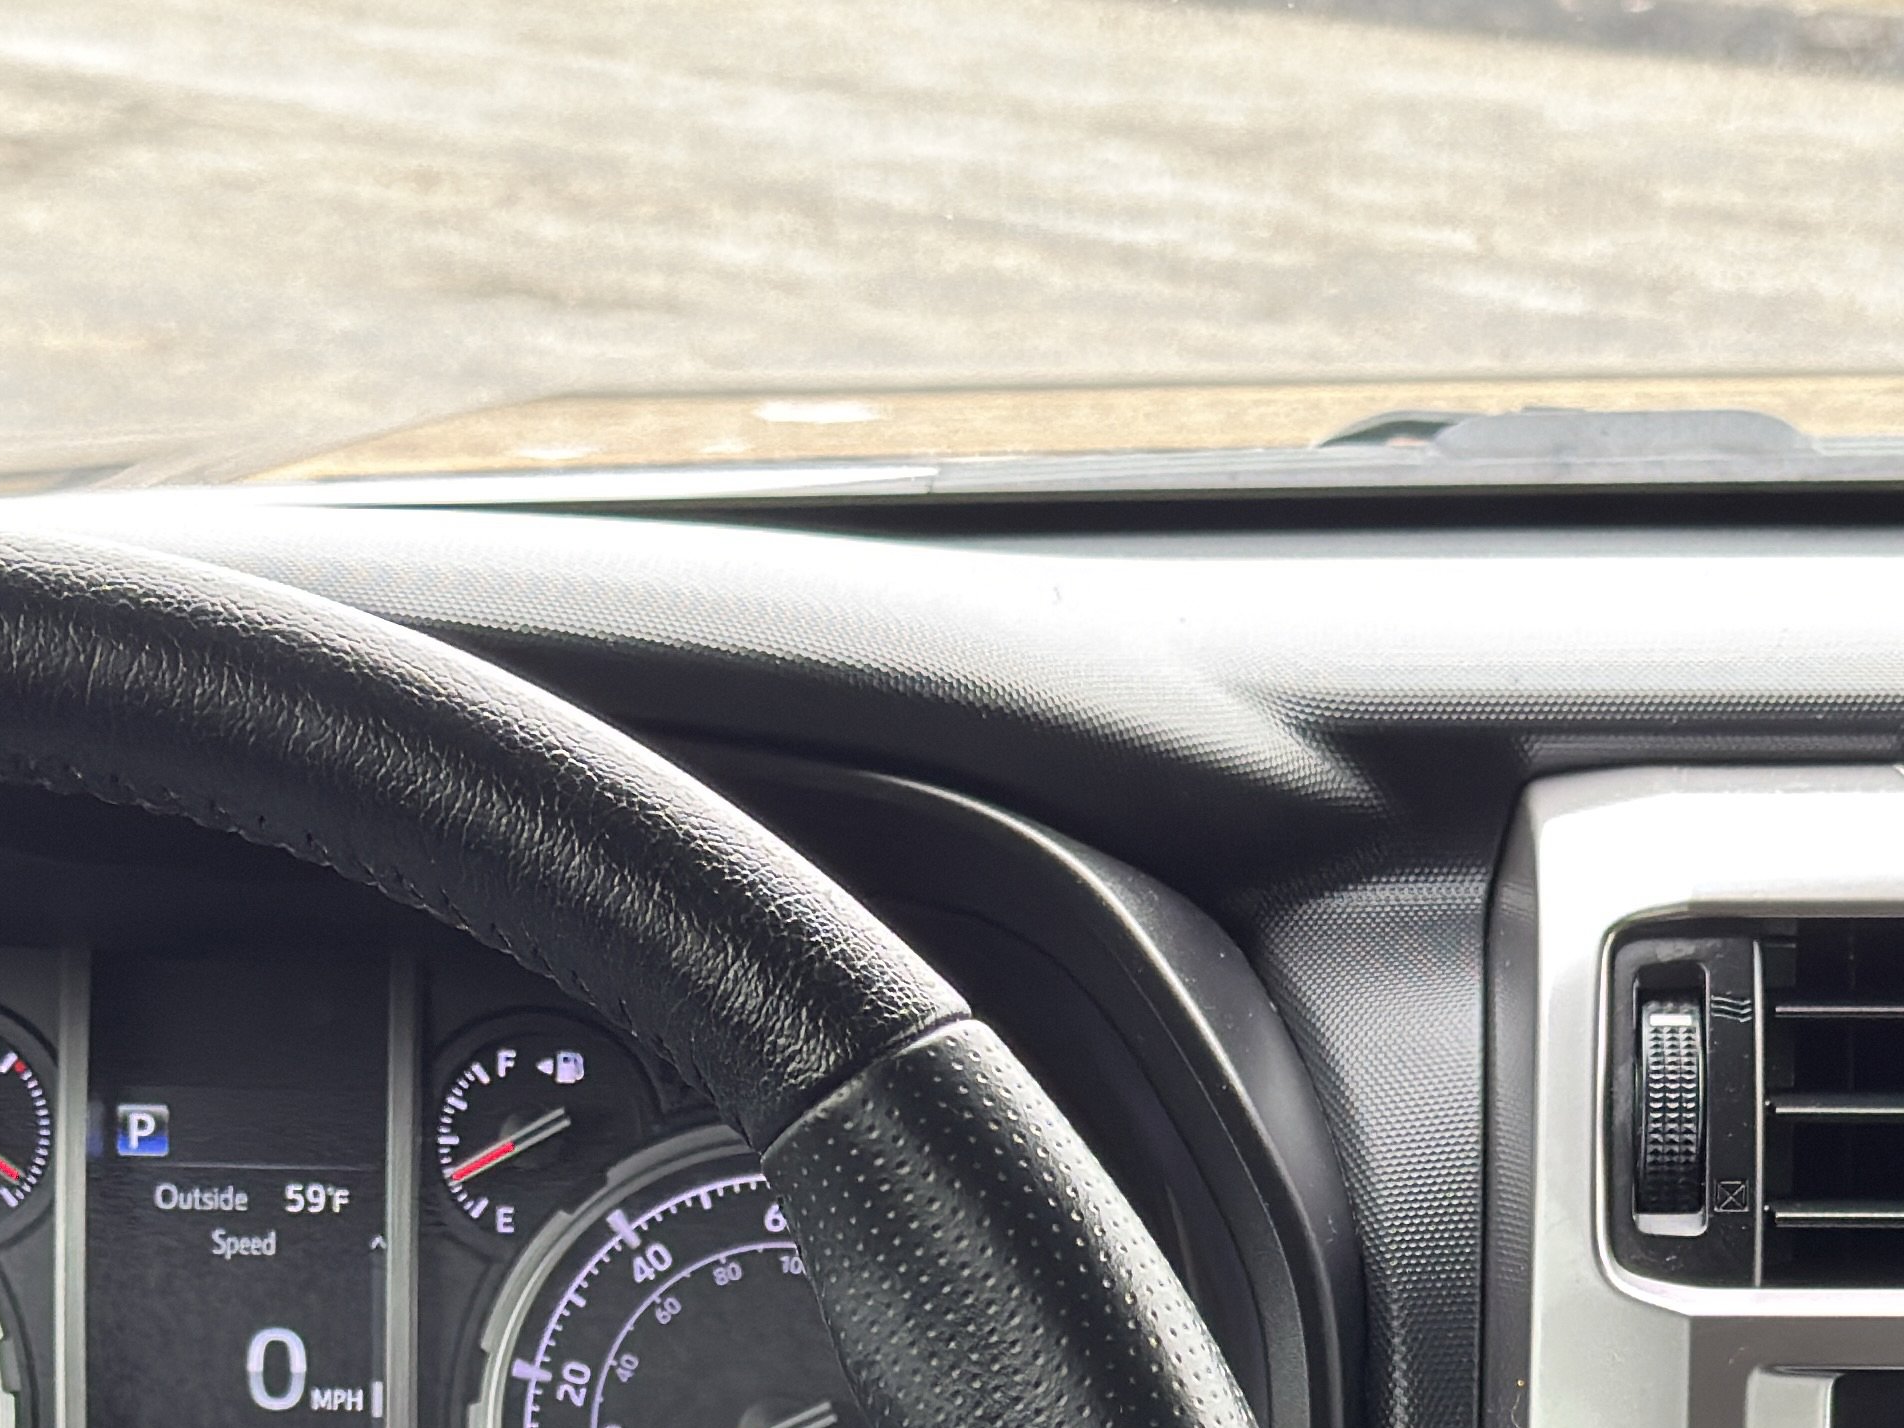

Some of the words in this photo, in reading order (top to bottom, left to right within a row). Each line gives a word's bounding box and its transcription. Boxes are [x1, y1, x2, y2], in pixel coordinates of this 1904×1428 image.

[496, 1050, 517, 1077] F
[127, 1111, 157, 1150] P
[153, 1183, 249, 1211] Outside
[496, 1207, 516, 1235] E
[211, 1228, 278, 1259] Speed
[631, 1242, 674, 1284] 40
[712, 1261, 744, 1287] 80
[654, 1296, 683, 1327] 60
[245, 1326, 308, 1413] 0
[310, 1389, 365, 1412] MPH
[614, 1352, 640, 1385] 40
[555, 1361, 592, 1408] 20
